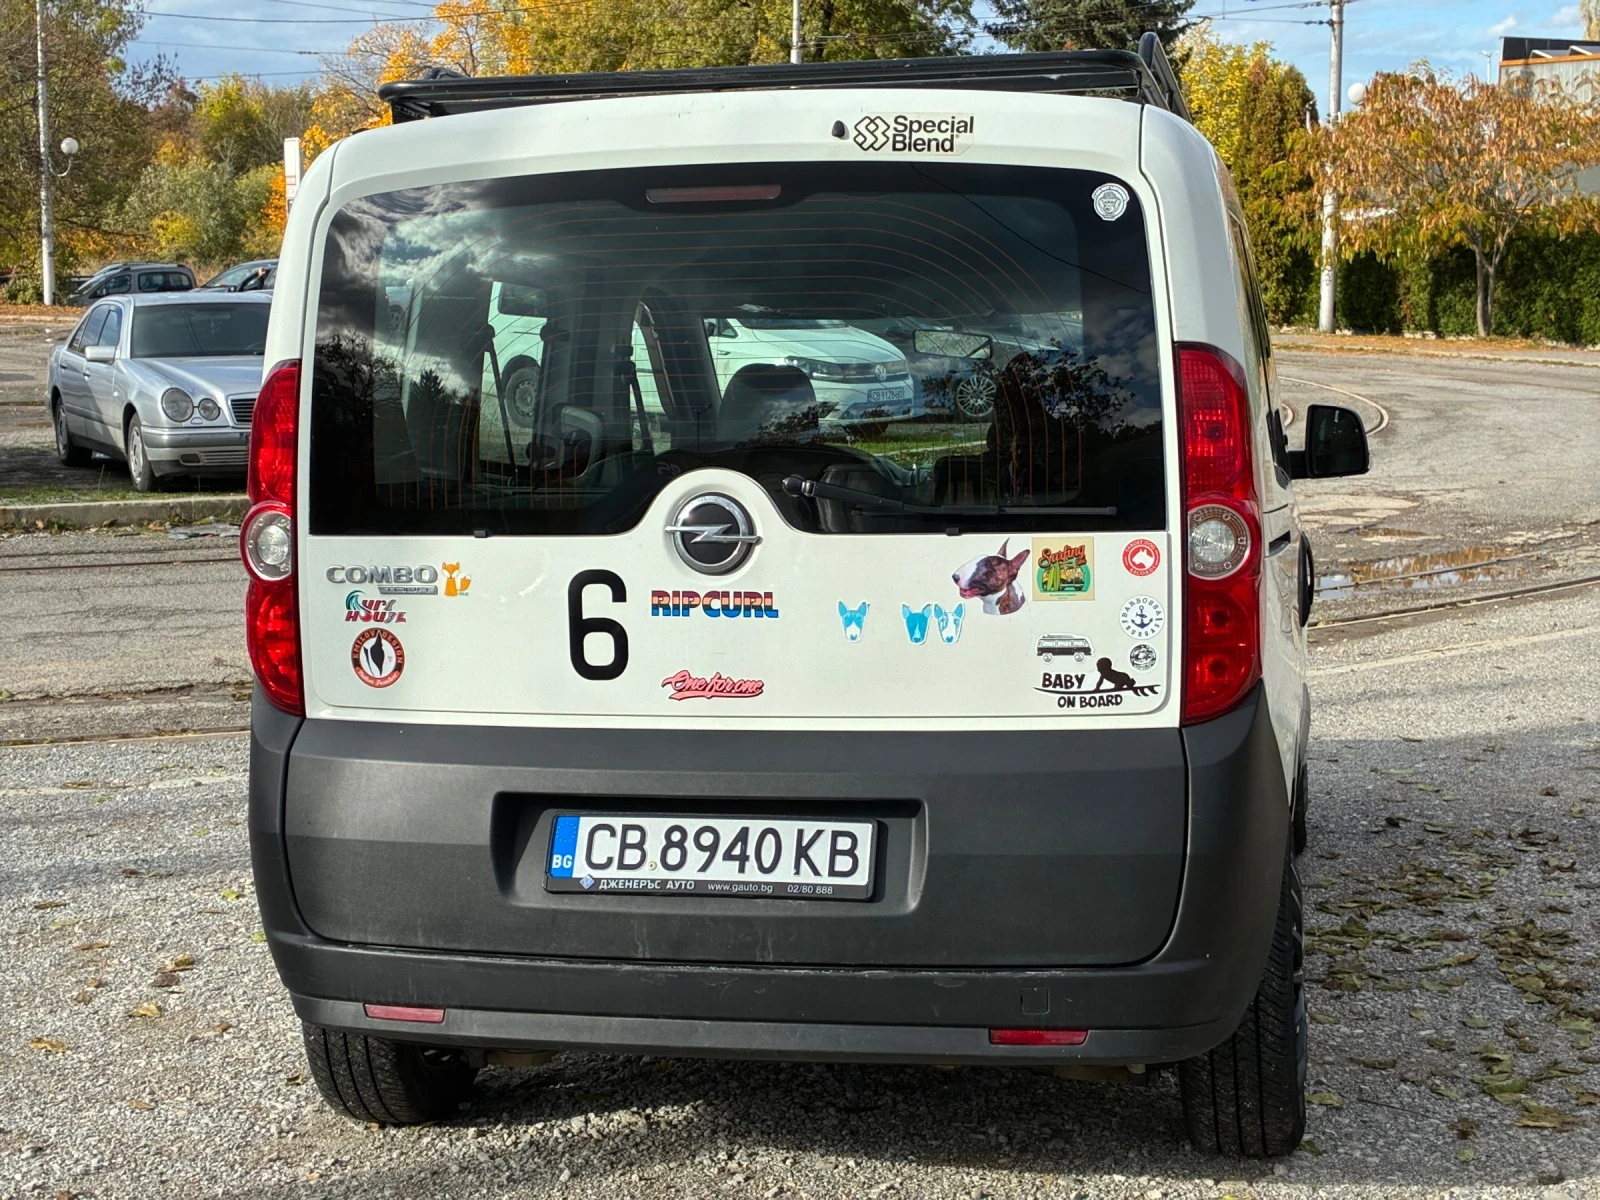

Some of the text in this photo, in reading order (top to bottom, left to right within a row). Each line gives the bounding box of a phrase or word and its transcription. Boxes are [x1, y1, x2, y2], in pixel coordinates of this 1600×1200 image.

[893, 115, 974, 140] Special
[892, 134, 954, 152] Blend
[1038, 545, 1087, 568] Surfing
[326, 565, 438, 584] COMBO
[567, 569, 629, 681] 6
[353, 630, 403, 664] EMILOV DESIGN
[1042, 672, 1085, 689] BABY
[1057, 694, 1123, 708] ON BOARD
[585, 823, 860, 878] CB 8940 KB
[551, 854, 573, 869] BG
[666, 880, 695, 891] АУТО
[707, 882, 834, 896] www.gauto.bg 02/80 888
